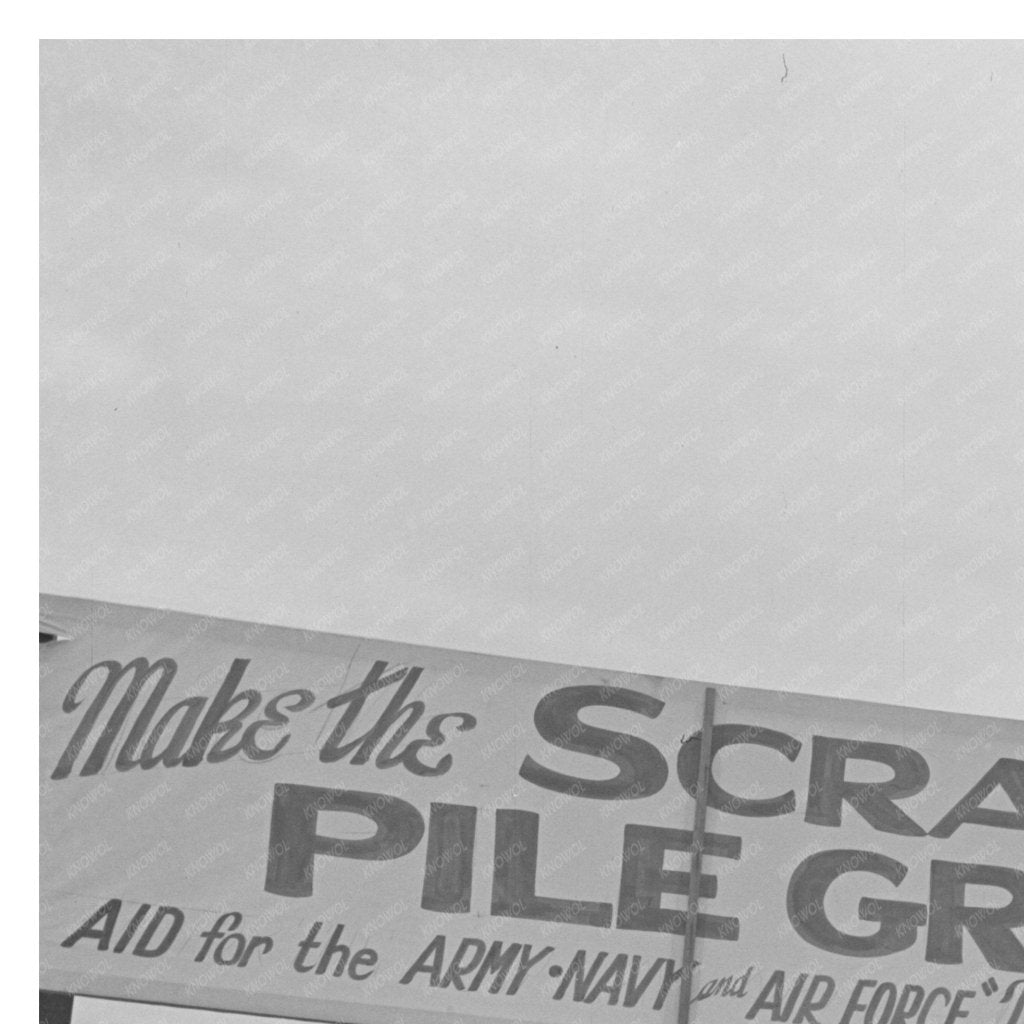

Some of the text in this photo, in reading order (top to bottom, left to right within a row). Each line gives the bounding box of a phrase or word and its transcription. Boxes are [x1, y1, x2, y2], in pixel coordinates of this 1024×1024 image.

[50, 656, 315, 780] Make
[318, 660, 478, 777] the
[264, 782, 743, 941] PILE
[61, 898, 185, 958] AID
[194, 910, 274, 968] for
[293, 920, 379, 981] the
[690, 966, 752, 1005] and
